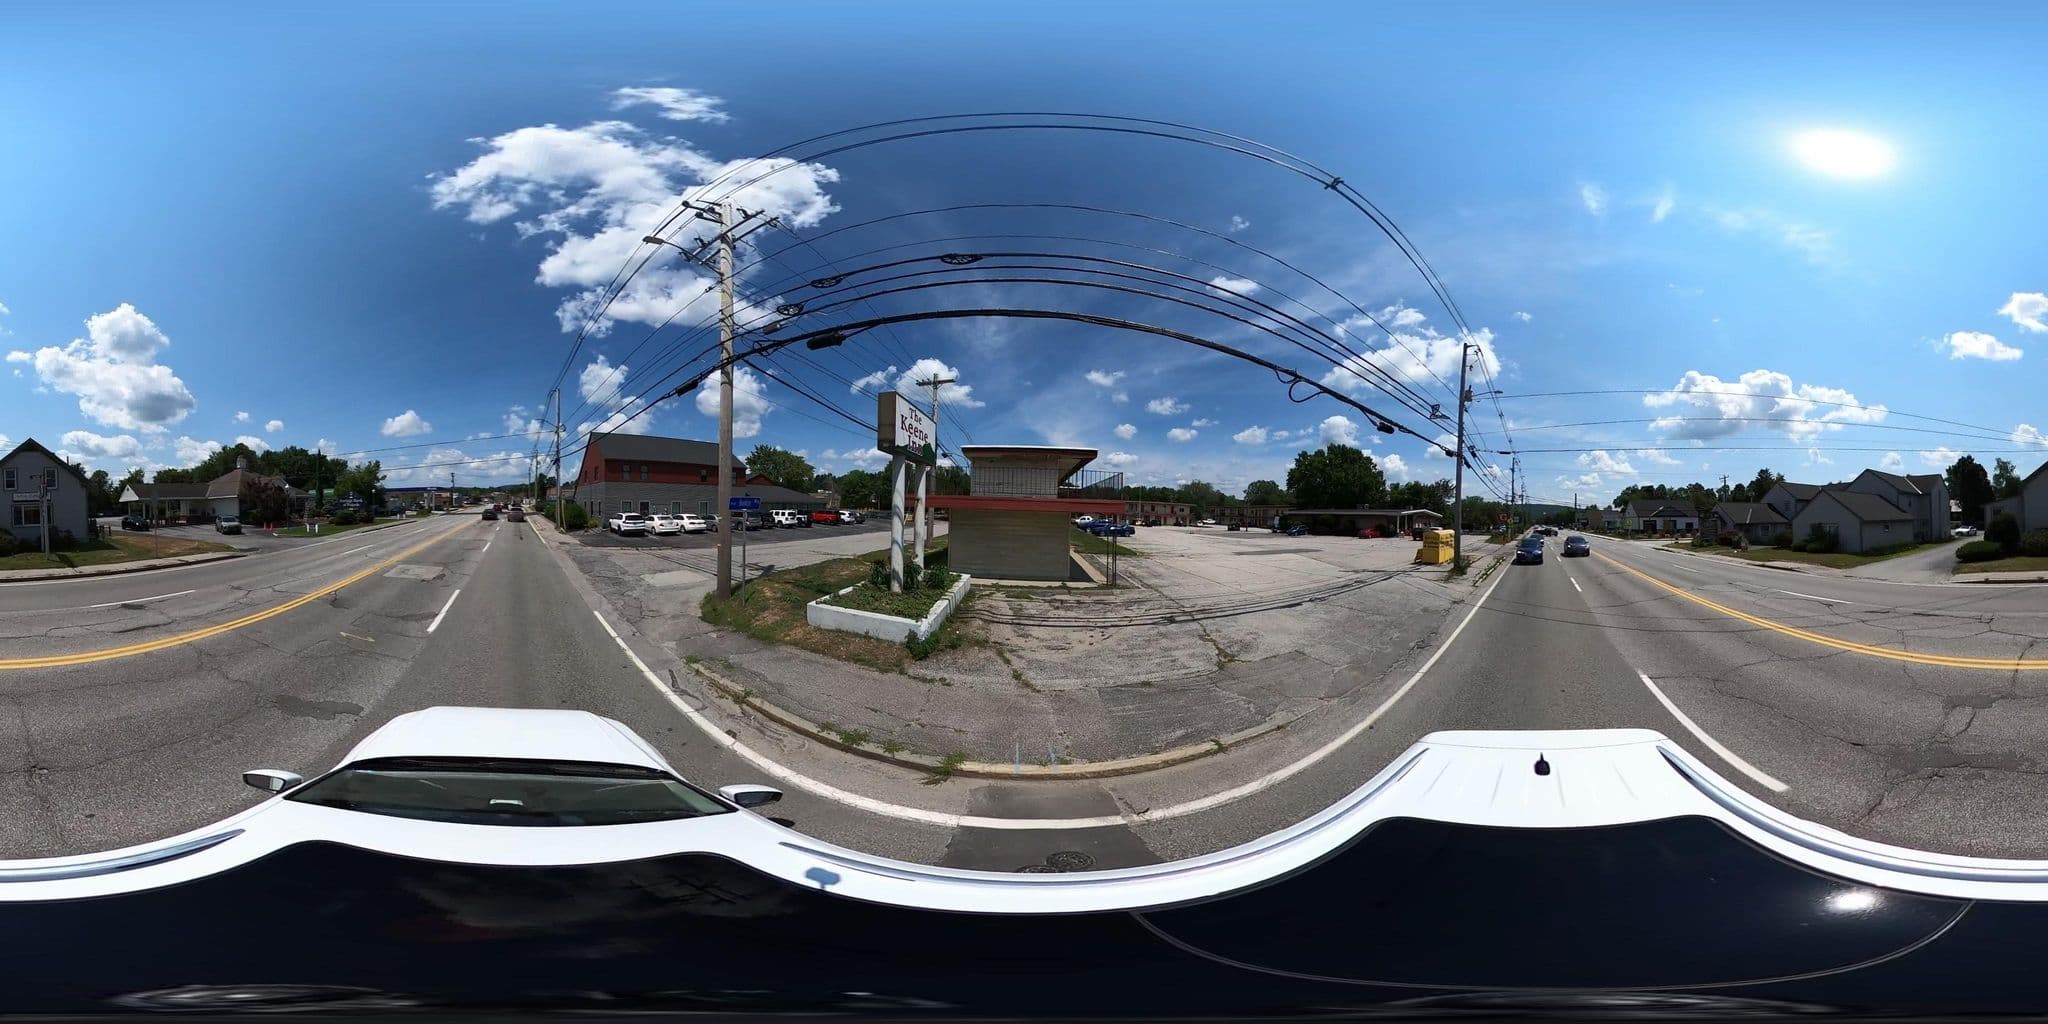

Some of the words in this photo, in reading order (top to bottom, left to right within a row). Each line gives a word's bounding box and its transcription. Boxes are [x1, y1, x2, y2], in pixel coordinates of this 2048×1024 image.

[909, 407, 922, 425] The
[901, 414, 928, 443] Keene
[907, 435, 923, 456] Inn
